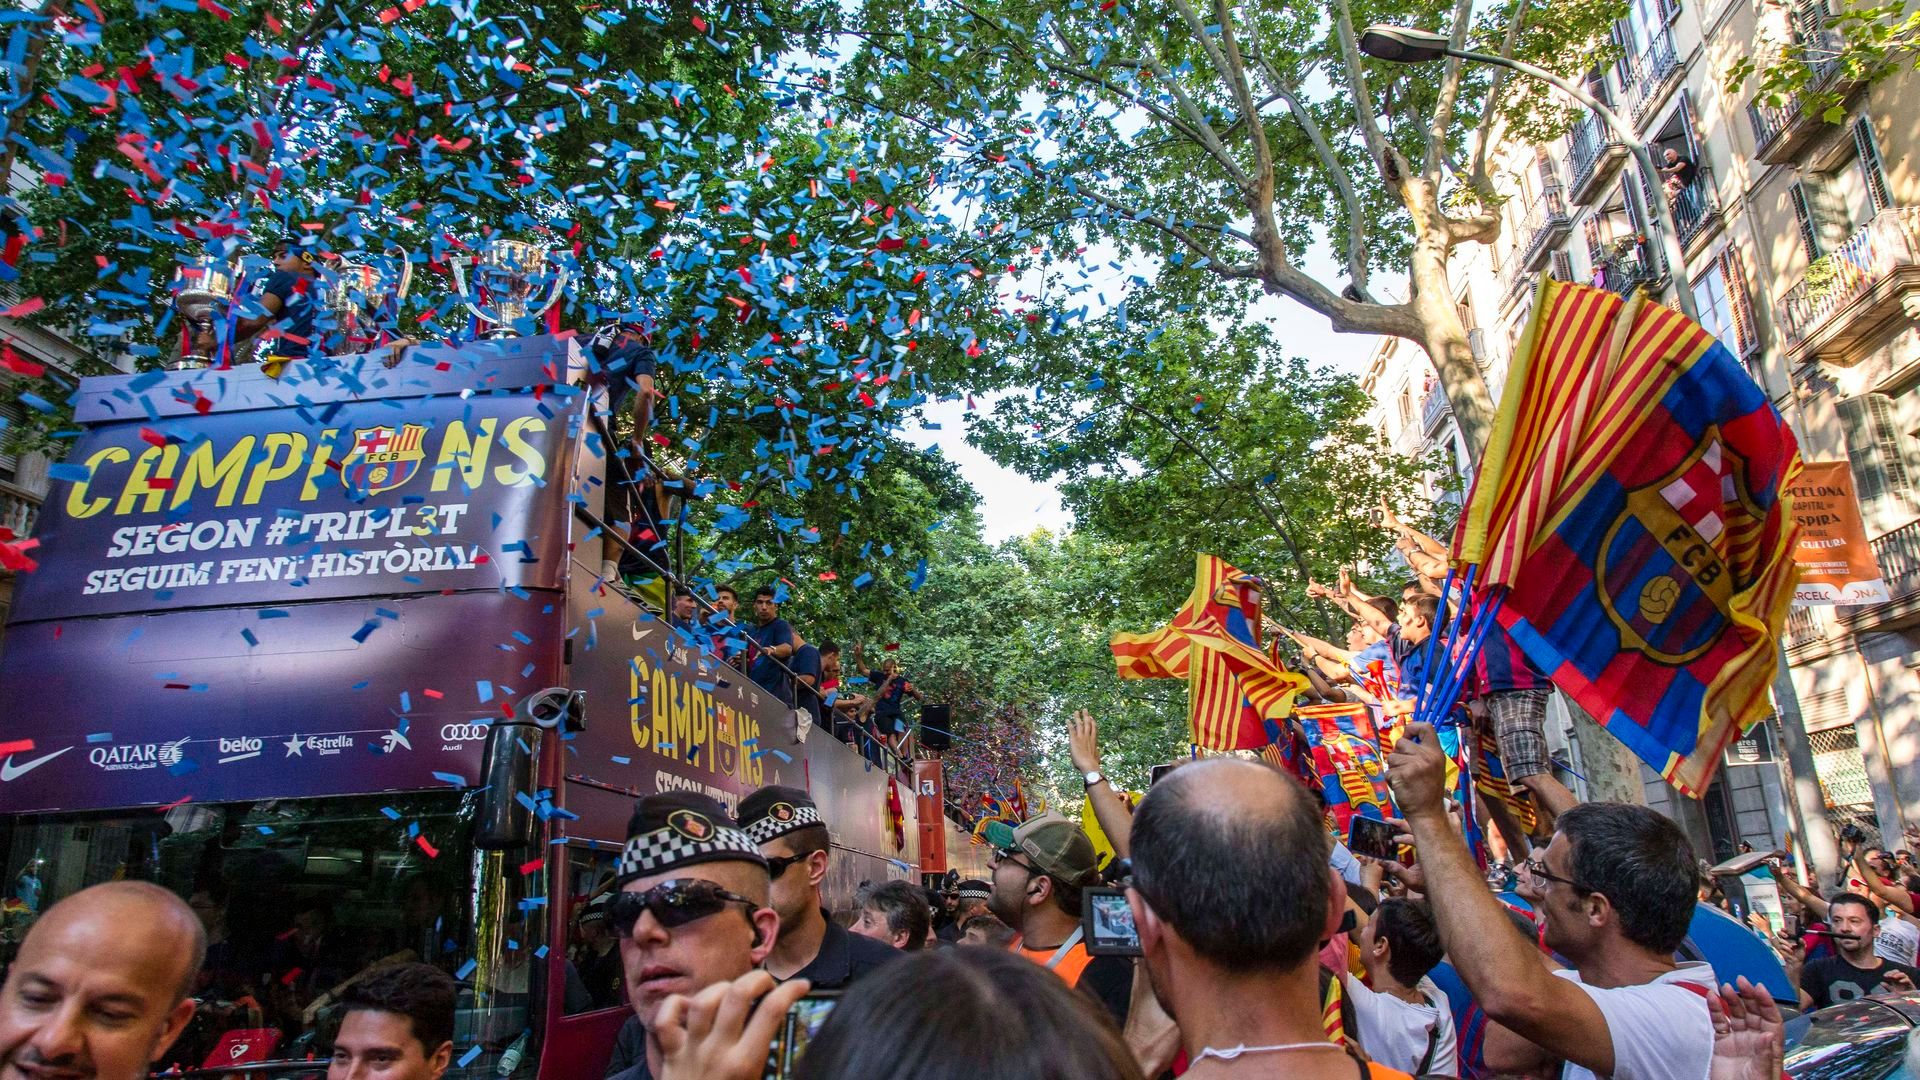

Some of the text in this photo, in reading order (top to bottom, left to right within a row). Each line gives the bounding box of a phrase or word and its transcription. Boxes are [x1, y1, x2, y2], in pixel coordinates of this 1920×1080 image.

[368, 452, 399, 463] FCB
[66, 416, 547, 519] CAMPINS
[1784, 486, 1846, 497] CELONA
[1792, 501, 1826, 511] CAPITAL
[1796, 513, 1841, 527] SPIRA
[106, 503, 469, 558] SEGON #TRIPL3T
[1801, 537, 1847, 549] CULTURA
[1664, 525, 1721, 586] FCB
[82, 562, 214, 595] SEGUIM
[216, 555, 304, 584] FENT
[1792, 588, 1881, 601] ARCELONA
[631, 655, 763, 789] CAMPINS
[219, 736, 263, 753] beko
[306, 735, 354, 750] Estrella
[89, 744, 157, 767] QATAR
